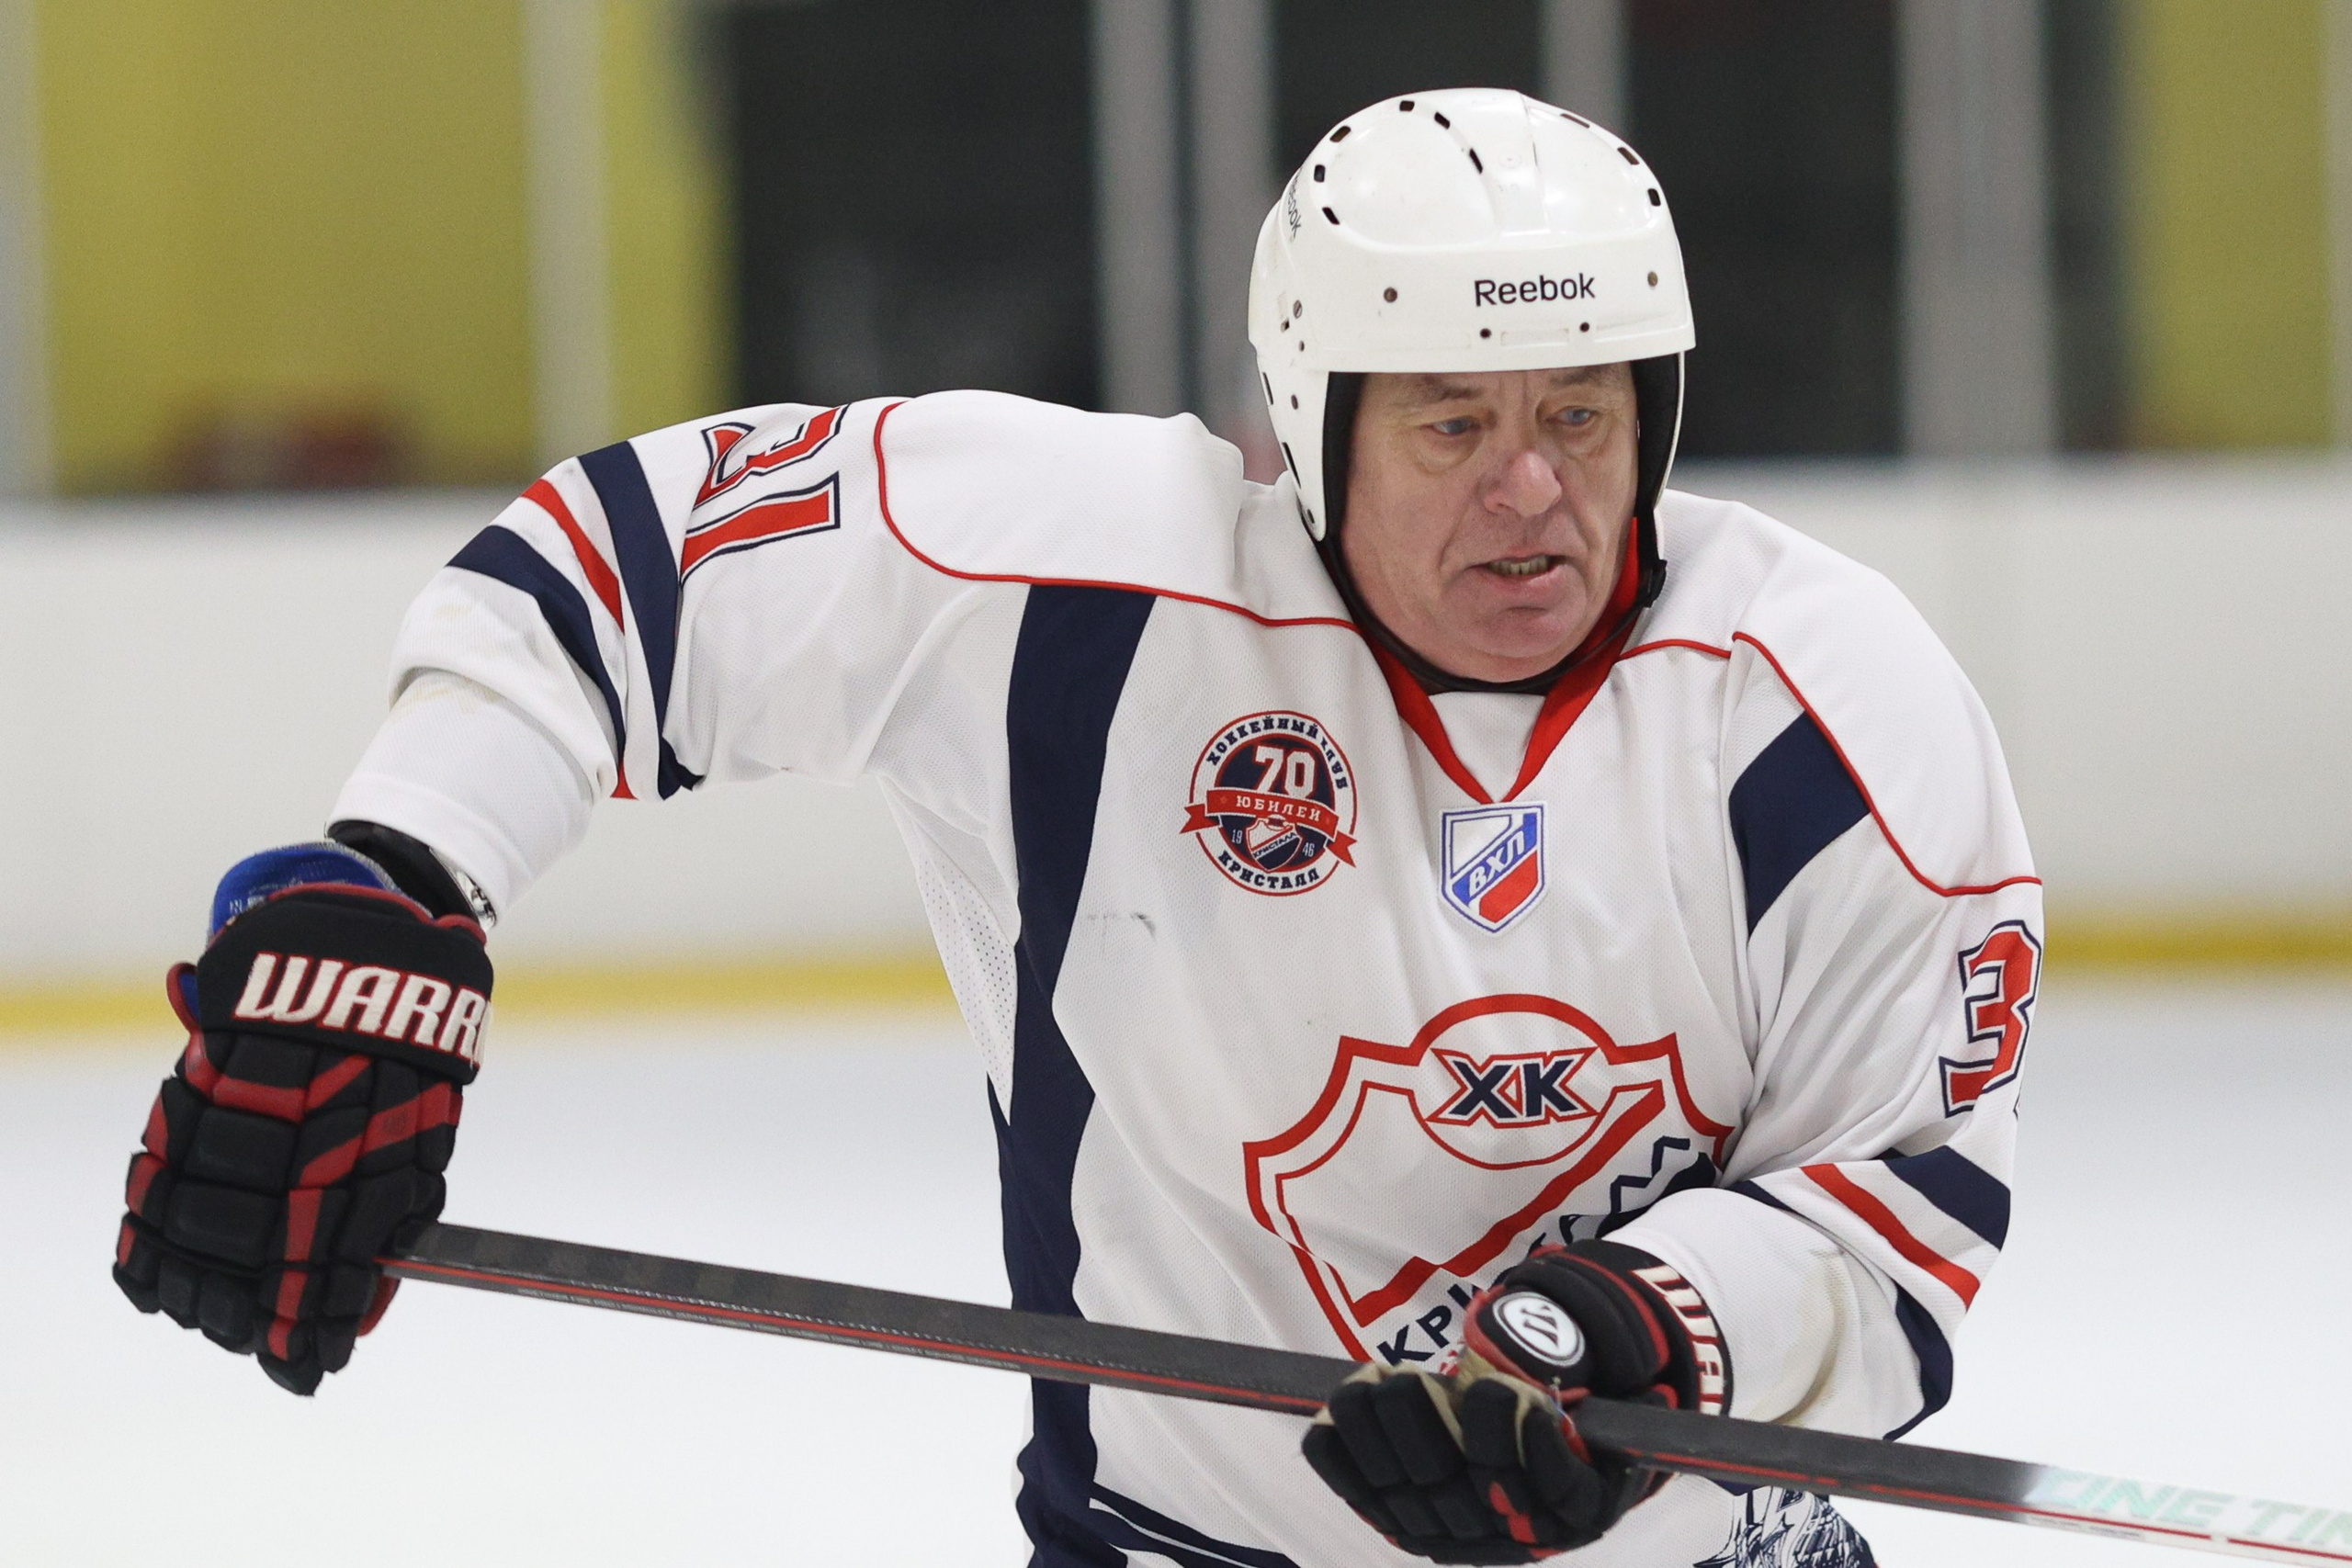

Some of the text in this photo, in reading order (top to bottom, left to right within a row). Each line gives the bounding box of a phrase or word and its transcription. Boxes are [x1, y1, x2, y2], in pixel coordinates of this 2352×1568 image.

[1474, 272, 1595, 307] Reebok
[1206, 716, 1318, 766] ХОККЕЙНЫЙ
[1255, 745, 1316, 799] 70
[1231, 829, 1243, 844] 19
[1302, 841, 1315, 857] 46
[1217, 851, 1319, 889] КРИСТАЛЛ
[2024, 1467, 2235, 1528] ONE
